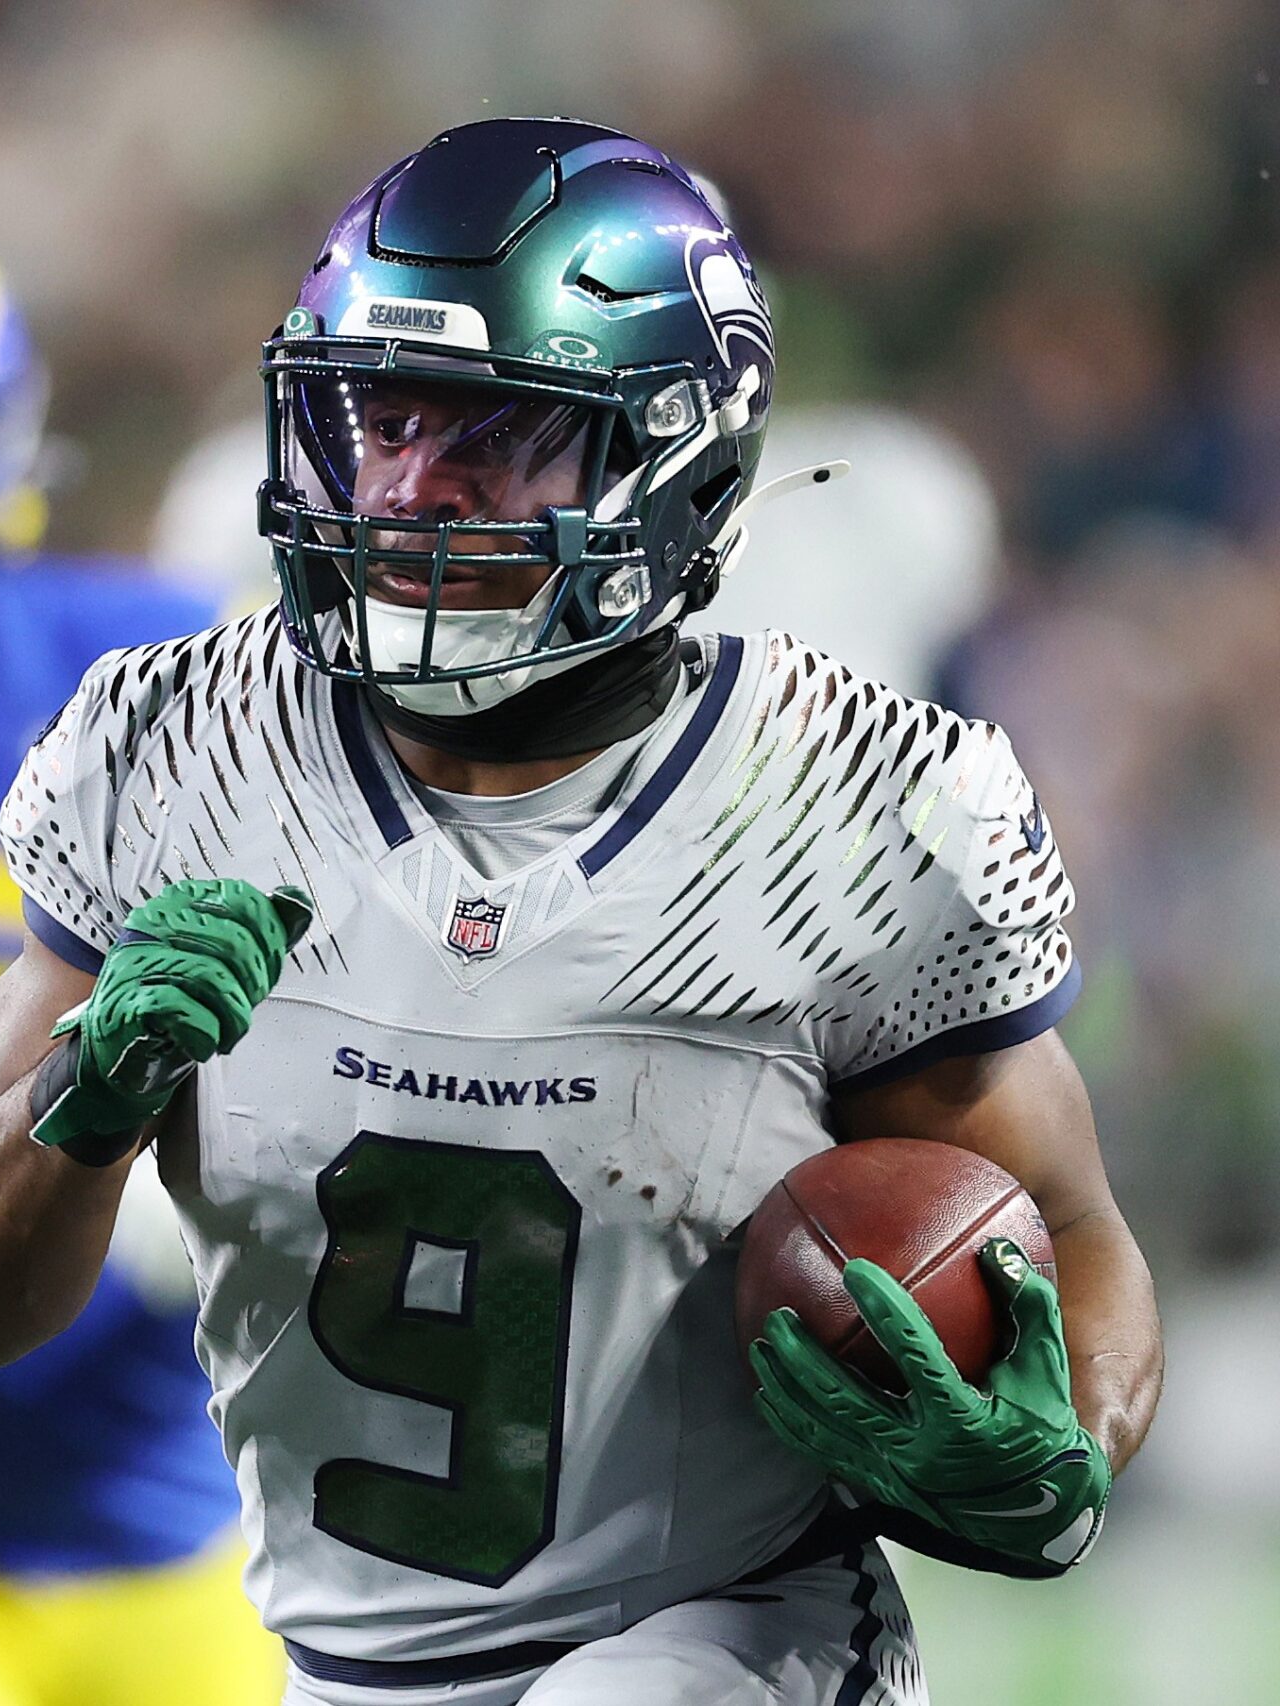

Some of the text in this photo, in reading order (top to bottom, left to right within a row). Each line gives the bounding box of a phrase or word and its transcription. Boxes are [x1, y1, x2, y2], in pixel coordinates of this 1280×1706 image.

[367, 303, 447, 332] SEAHAWKS
[452, 918, 494, 950] NFL
[332, 1046, 598, 1107] SEAHAWKS
[307, 1128, 583, 1590] 9
